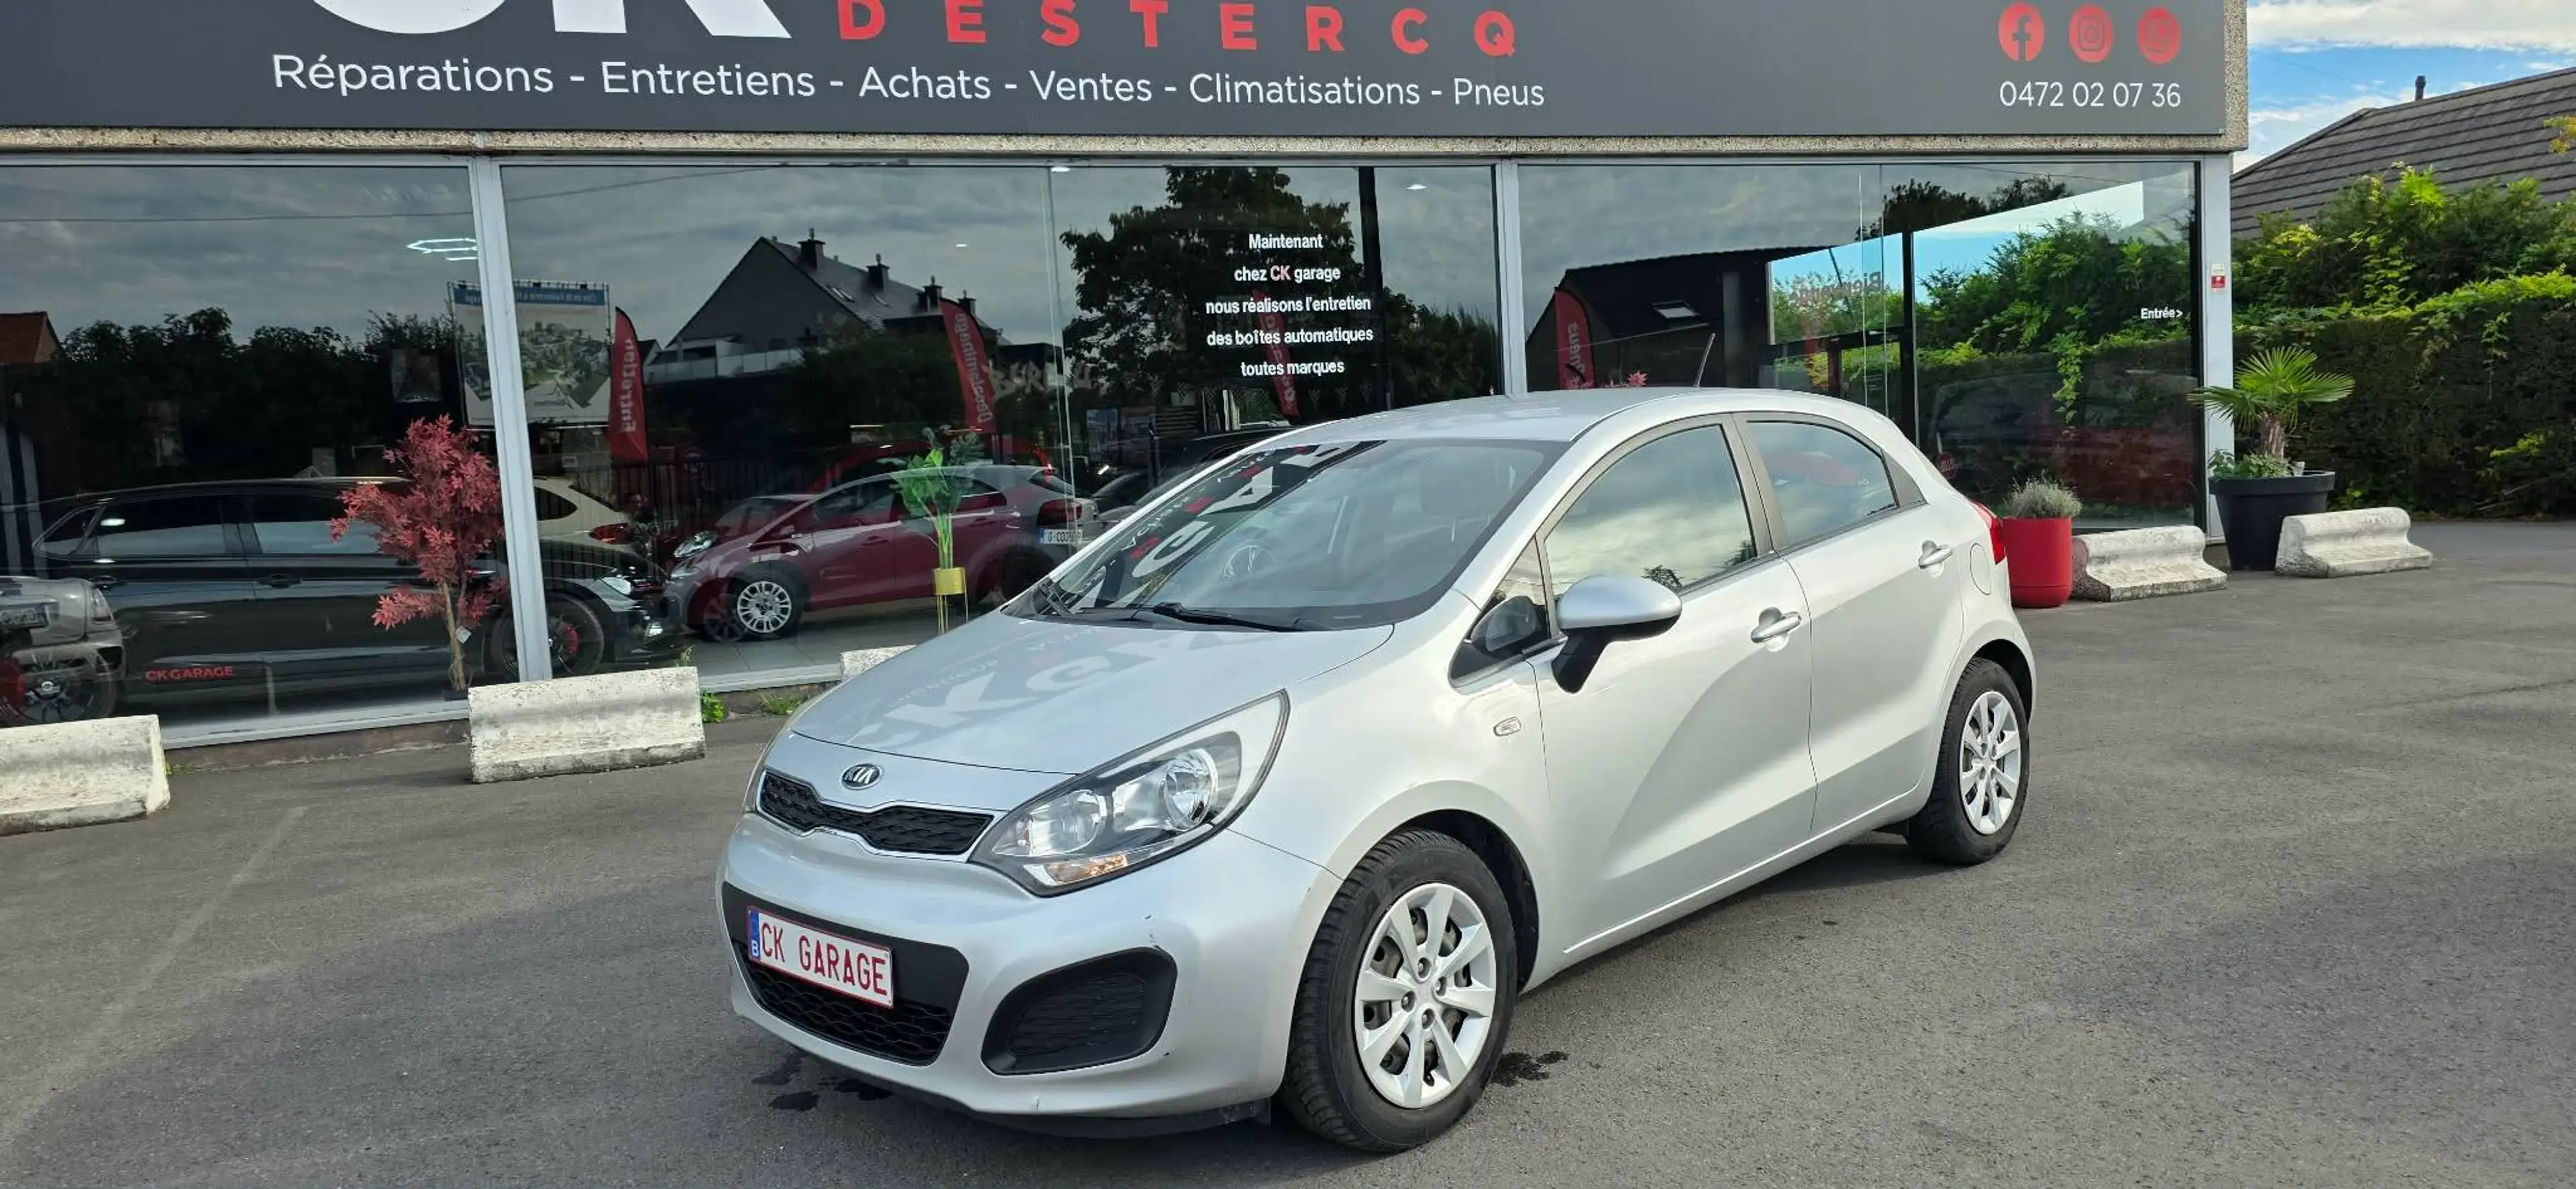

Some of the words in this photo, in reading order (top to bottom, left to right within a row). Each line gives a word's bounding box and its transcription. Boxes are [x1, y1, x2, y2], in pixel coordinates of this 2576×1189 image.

[837, 0, 1515, 56] DESTERCQ
[272, 54, 554, 97] Réparations
[601, 60, 815, 97] Entretiens
[859, 66, 991, 99] Achats
[1028, 70, 1152, 102] Ventes
[1189, 72, 1420, 105] Climatisations
[1454, 77, 1545, 106] Pneus
[2000, 80, 2064, 107] 0472
[2072, 81, 2104, 107] 02
[2112, 82, 2143, 107] 07
[2151, 82, 2182, 108] 36
[1248, 233, 1324, 249] Maintenant
[1234, 266, 1267, 282] chez
[1271, 266, 1291, 281] CK
[1294, 268, 1341, 284] garage
[1205, 301, 1240, 314] nous
[1242, 297, 1304, 313] réalisons
[1305, 295, 1371, 311] l'entretien
[1207, 331, 1233, 346] des
[1235, 329, 1281, 345] boîtes
[1284, 327, 1374, 344] automatiques
[1240, 361, 1285, 377] toutes
[1287, 361, 1345, 377] marques
[843, 766, 876, 784] KIA
[751, 940, 759, 958] B
[761, 922, 786, 963] CK
[798, 935, 888, 997] GARAGE
